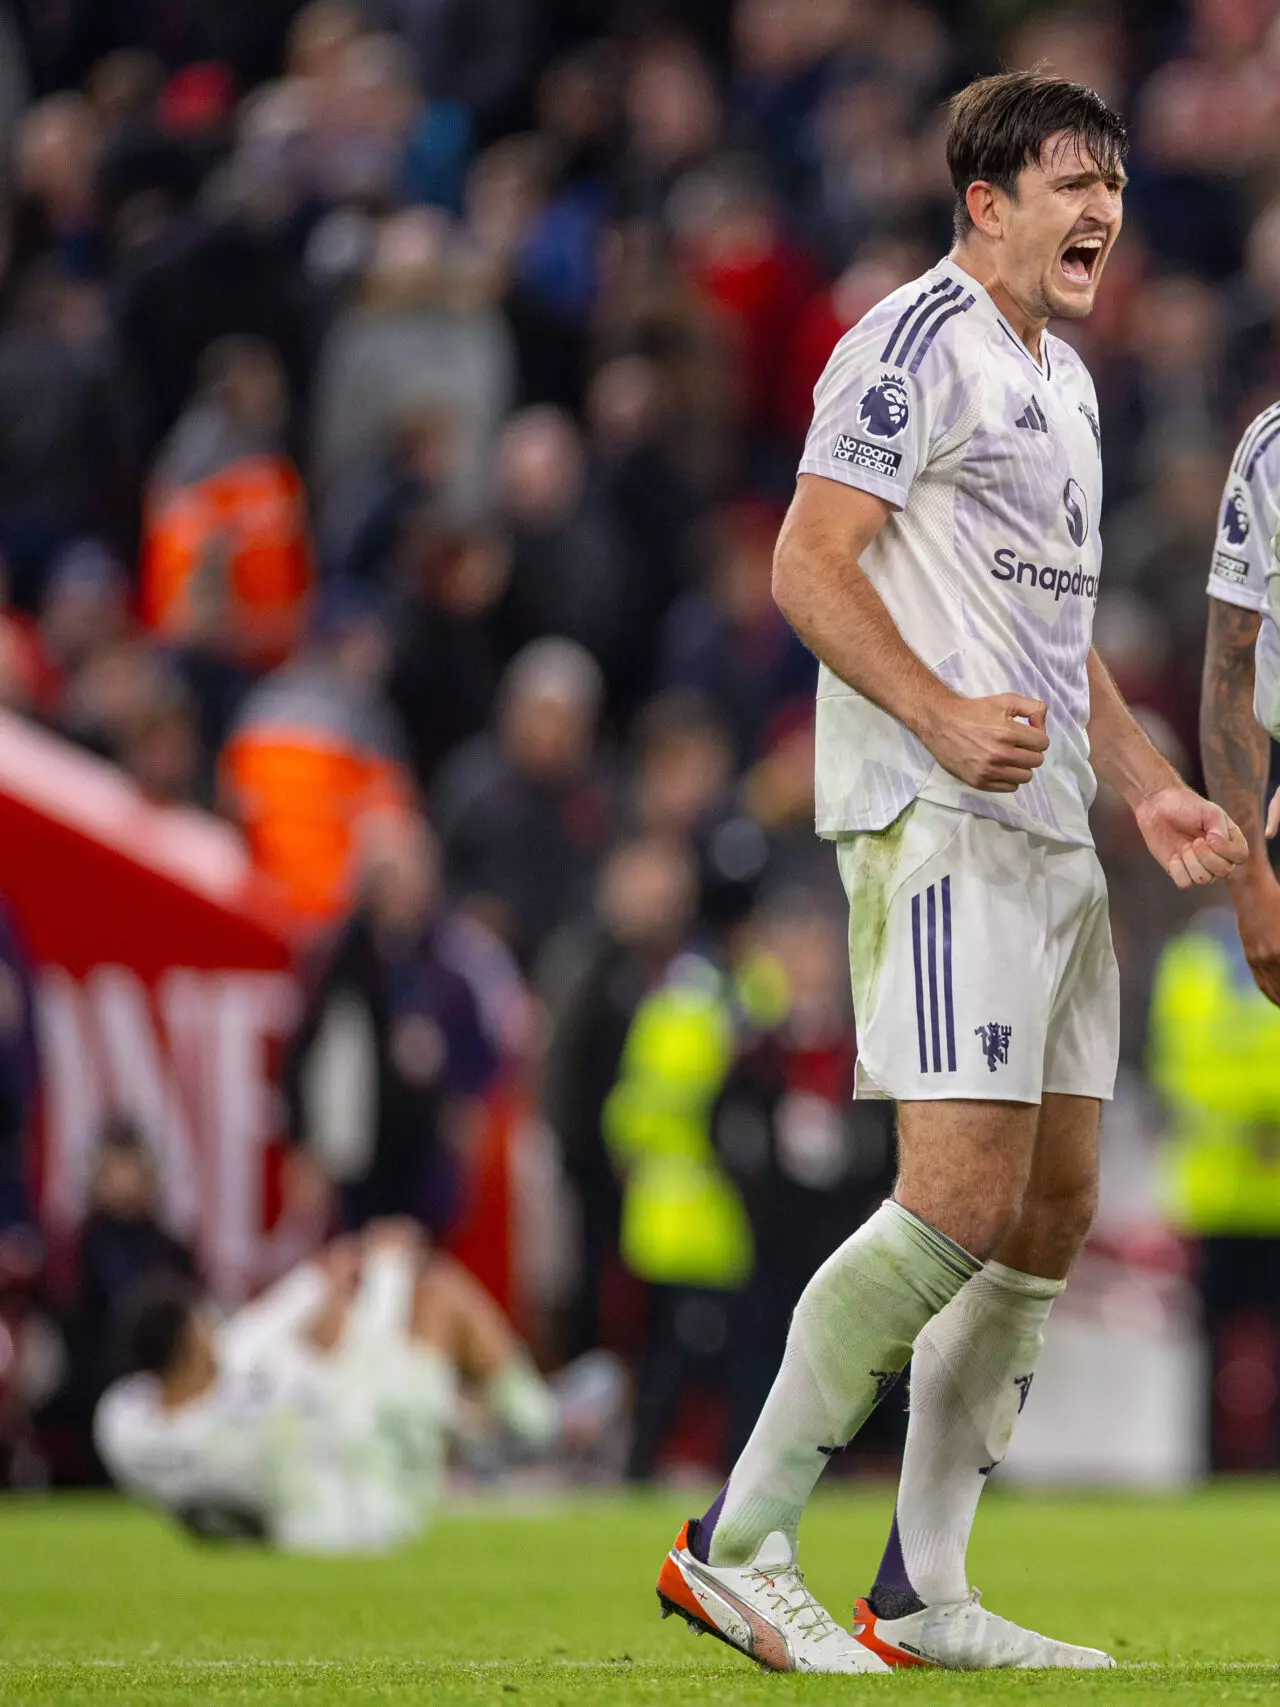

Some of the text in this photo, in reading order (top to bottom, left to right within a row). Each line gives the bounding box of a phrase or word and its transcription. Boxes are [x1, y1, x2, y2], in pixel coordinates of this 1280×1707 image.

[836, 434, 895, 465] No room
[853, 453, 897, 477] racism
